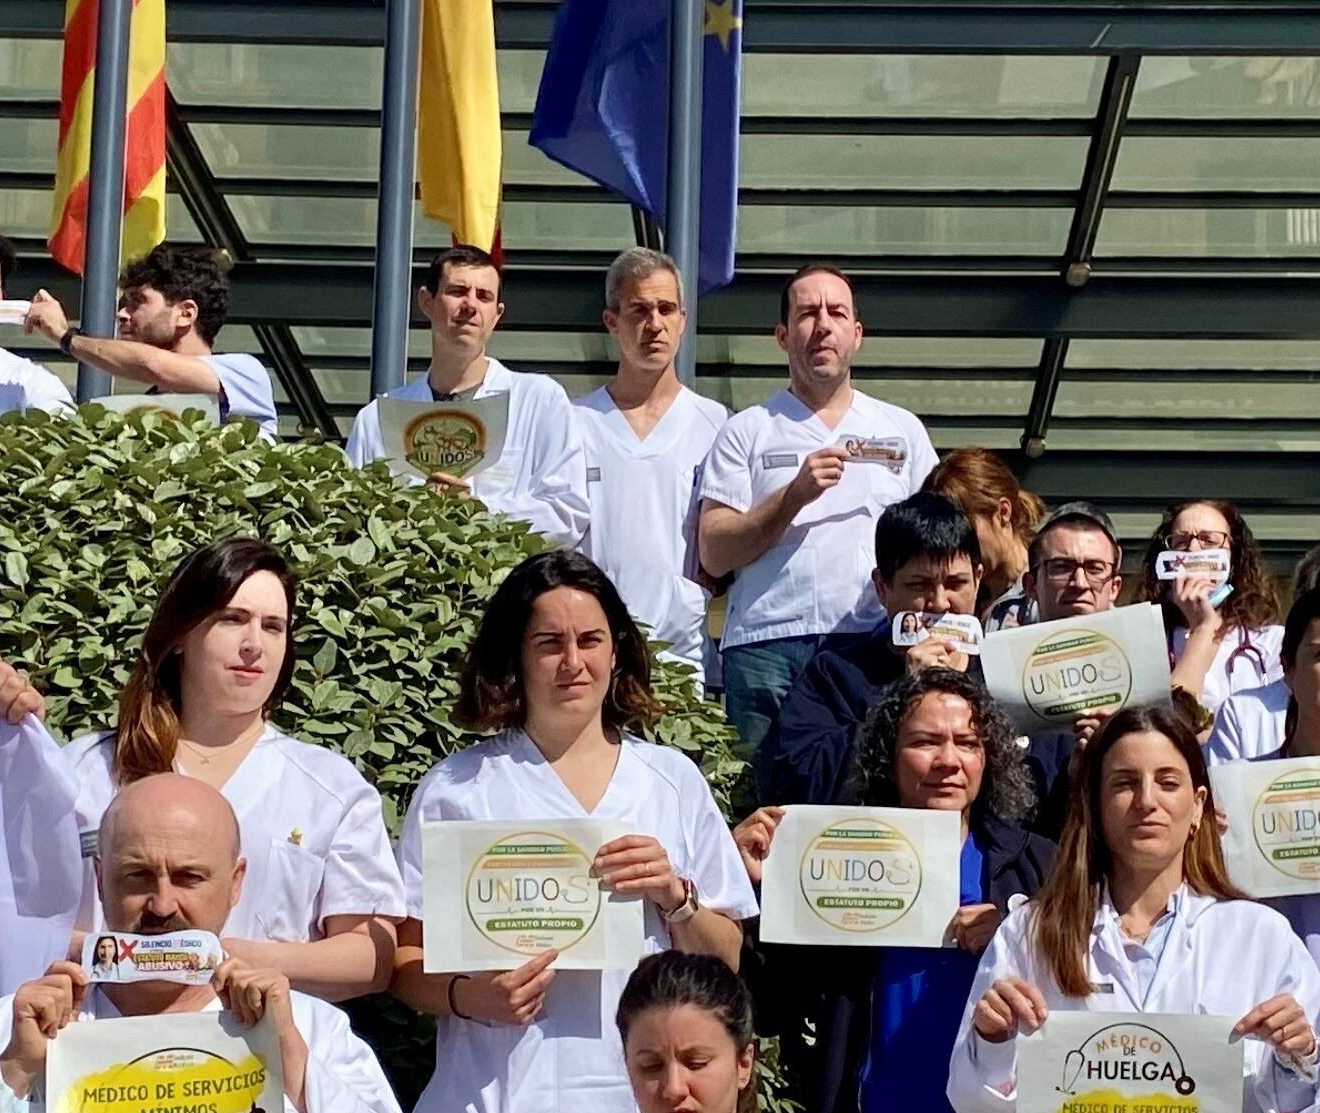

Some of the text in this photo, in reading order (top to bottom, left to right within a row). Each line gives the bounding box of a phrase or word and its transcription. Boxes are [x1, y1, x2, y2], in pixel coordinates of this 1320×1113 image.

[1030, 655, 1121, 695] UNIDOS
[810, 857, 913, 886] UNIDOS
[477, 875, 591, 904] UNIDOS
[824, 897, 899, 908] ESTATUTO PROPIO
[494, 919, 577, 930] ESTATUTO PROPIO
[1096, 1033, 1162, 1054] MÉDICO
[1123, 1046, 1136, 1057] DE
[1087, 1061, 1176, 1081] HUELGA
[83, 1068, 266, 1104] MÉDICO DE SERVICIOS
